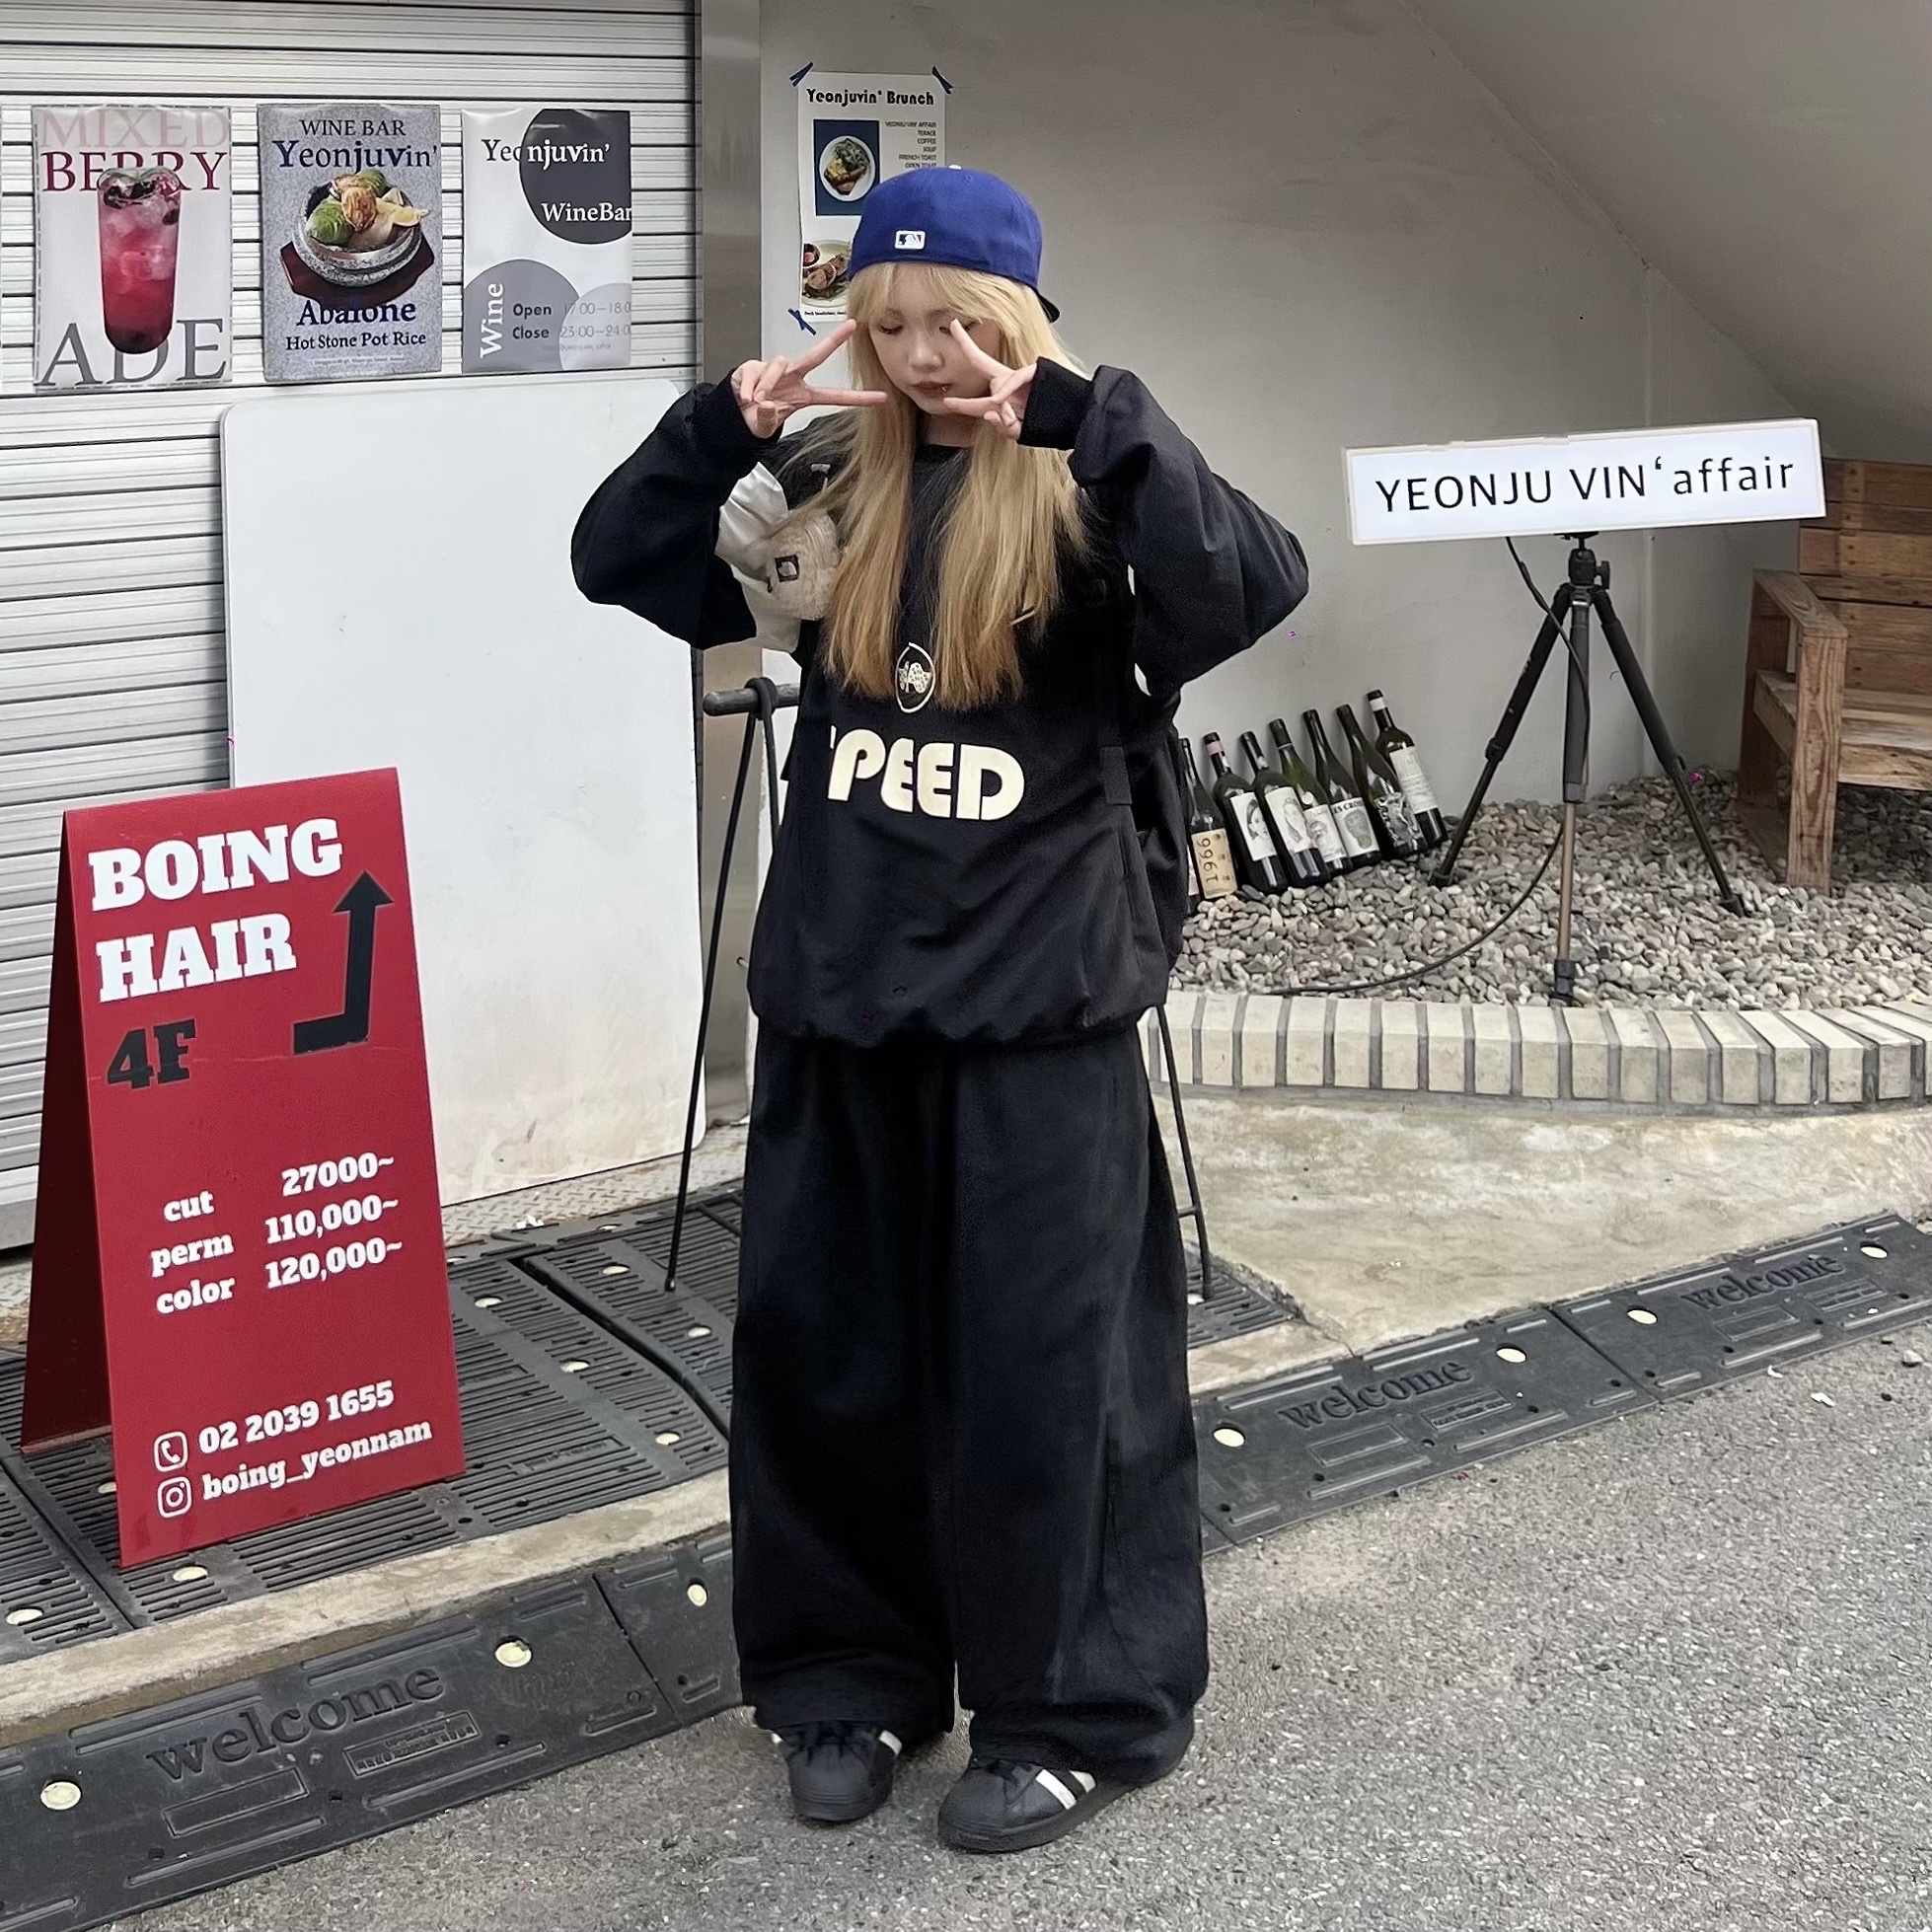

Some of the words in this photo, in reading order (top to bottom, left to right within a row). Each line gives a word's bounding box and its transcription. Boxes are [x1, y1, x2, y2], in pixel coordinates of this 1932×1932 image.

[40, 110, 228, 148] MIXED
[299, 119, 355, 136] WINE
[362, 119, 406, 136] BAR
[806, 89, 882, 107] Yeonjuvin'
[887, 91, 934, 106] Brunch
[272, 139, 437, 174] Yeonjuvin'
[285, 336, 315, 350] Hot
[318, 334, 357, 349] Stone
[361, 333, 388, 347] Pot
[393, 331, 426, 346] Rice
[480, 282, 503, 358] Wine
[512, 304, 553, 320] Open
[512, 326, 550, 339] Close
[1375, 470, 1552, 512] YEONJU
[828, 725, 1025, 821] PEED
[88, 818, 343, 912] BOING
[96, 913, 297, 1003] HAIR
[107, 1018, 196, 1089] 4F
[164, 1190, 215, 1222] cut
[281, 1152, 395, 1196] 27000~
[150, 1234, 234, 1277] perm
[264, 1194, 399, 1244] 110,000~
[156, 1277, 236, 1314] color
[264, 1236, 403, 1289] 120,000~
[1680, 1255, 1846, 1312] welcome
[198, 1421, 239, 1453] 02
[245, 1400, 320, 1443] 2039
[326, 1379, 395, 1421] 1655
[1278, 1359, 1473, 1429] welcome
[201, 1421, 433, 1501] boing_yeonnam
[146, 1666, 445, 1782] welcome
